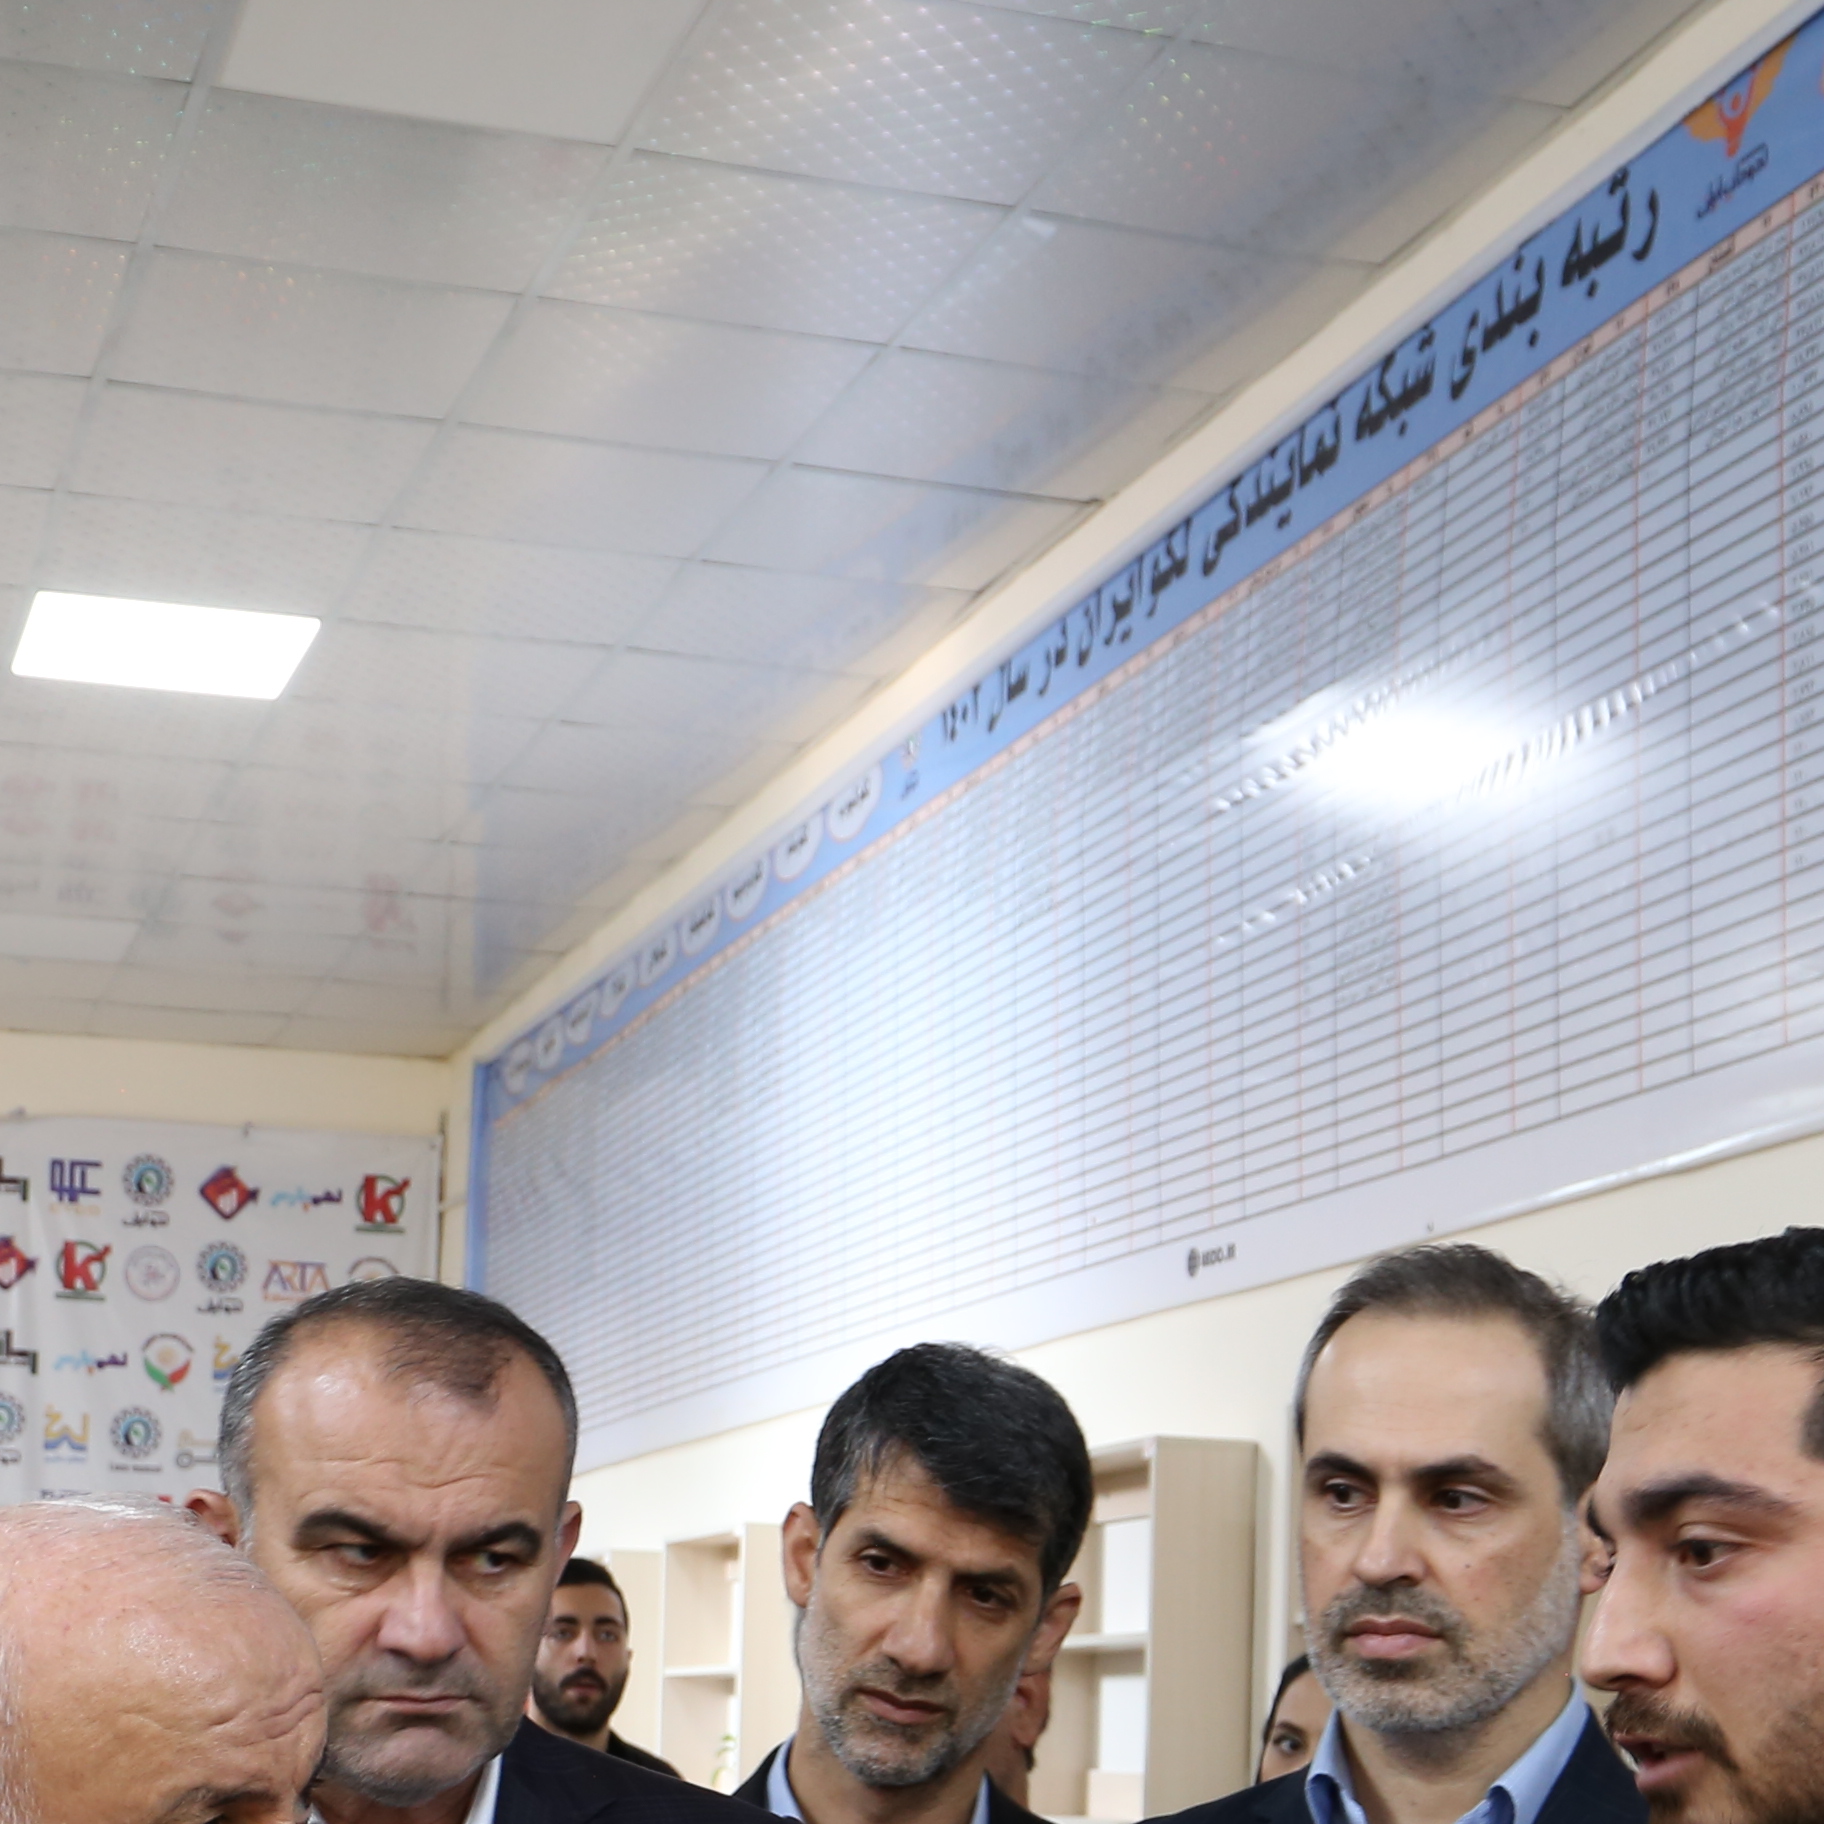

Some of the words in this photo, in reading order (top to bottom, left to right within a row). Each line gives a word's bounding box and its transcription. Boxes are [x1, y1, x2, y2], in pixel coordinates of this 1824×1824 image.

[1355, 325, 1437, 442] شبکه
[1450, 253, 1546, 401] بندی
[987, 659, 1031, 734] سال
